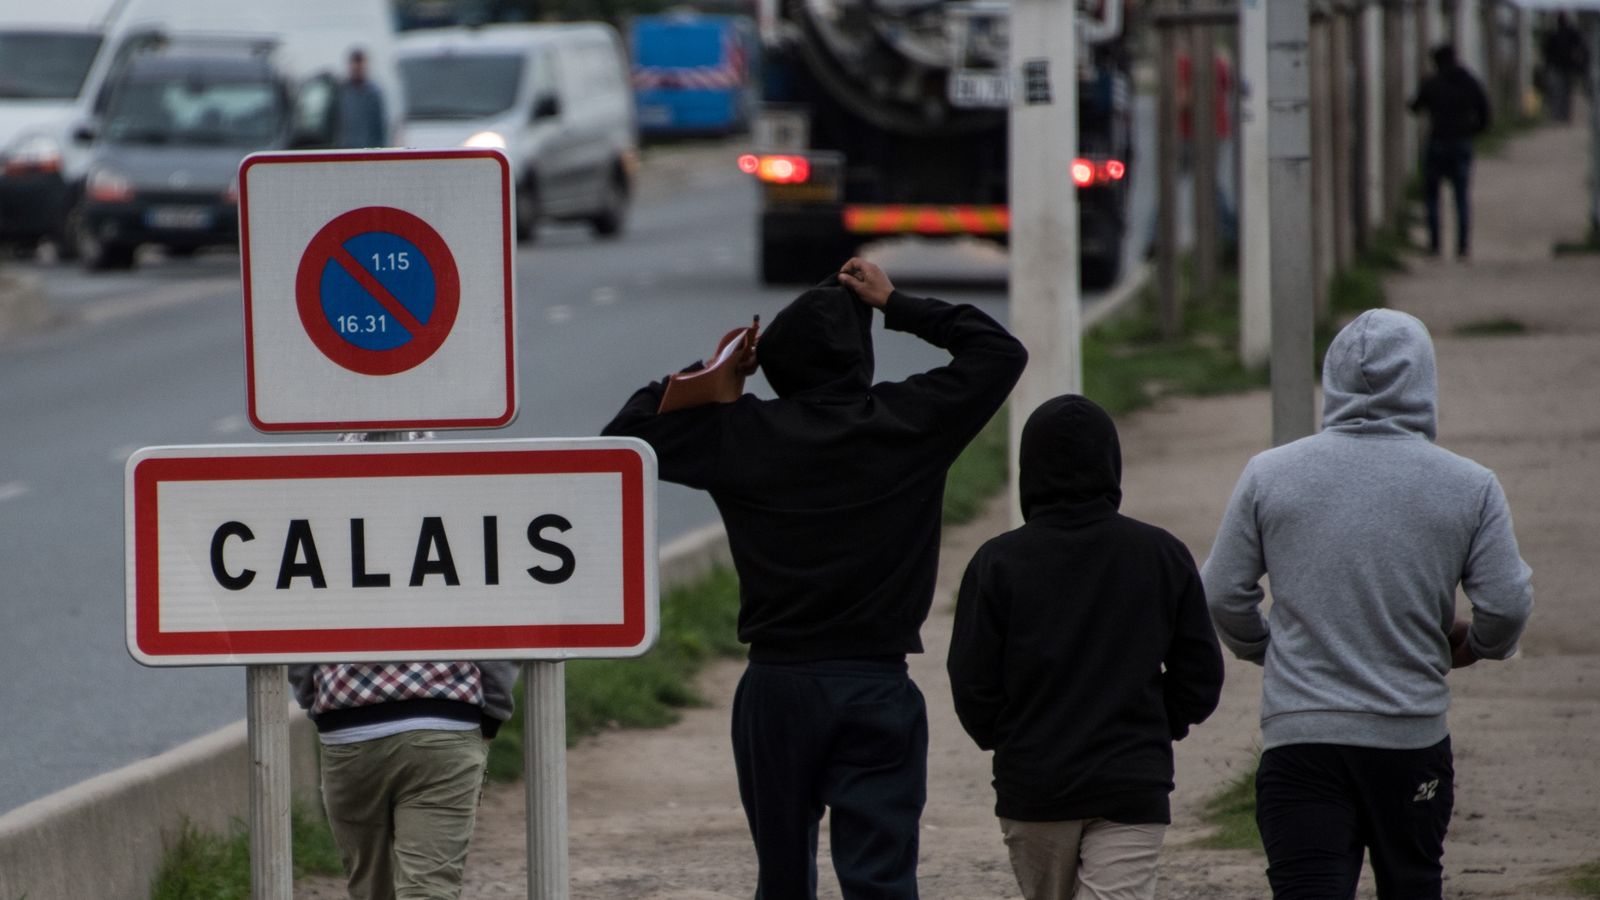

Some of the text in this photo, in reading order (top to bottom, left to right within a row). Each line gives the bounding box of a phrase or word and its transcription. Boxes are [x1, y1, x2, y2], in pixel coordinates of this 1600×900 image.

[372, 252, 410, 271] 1.15
[337, 315, 386, 333] 16.31
[210, 513, 576, 591] CALAIS
